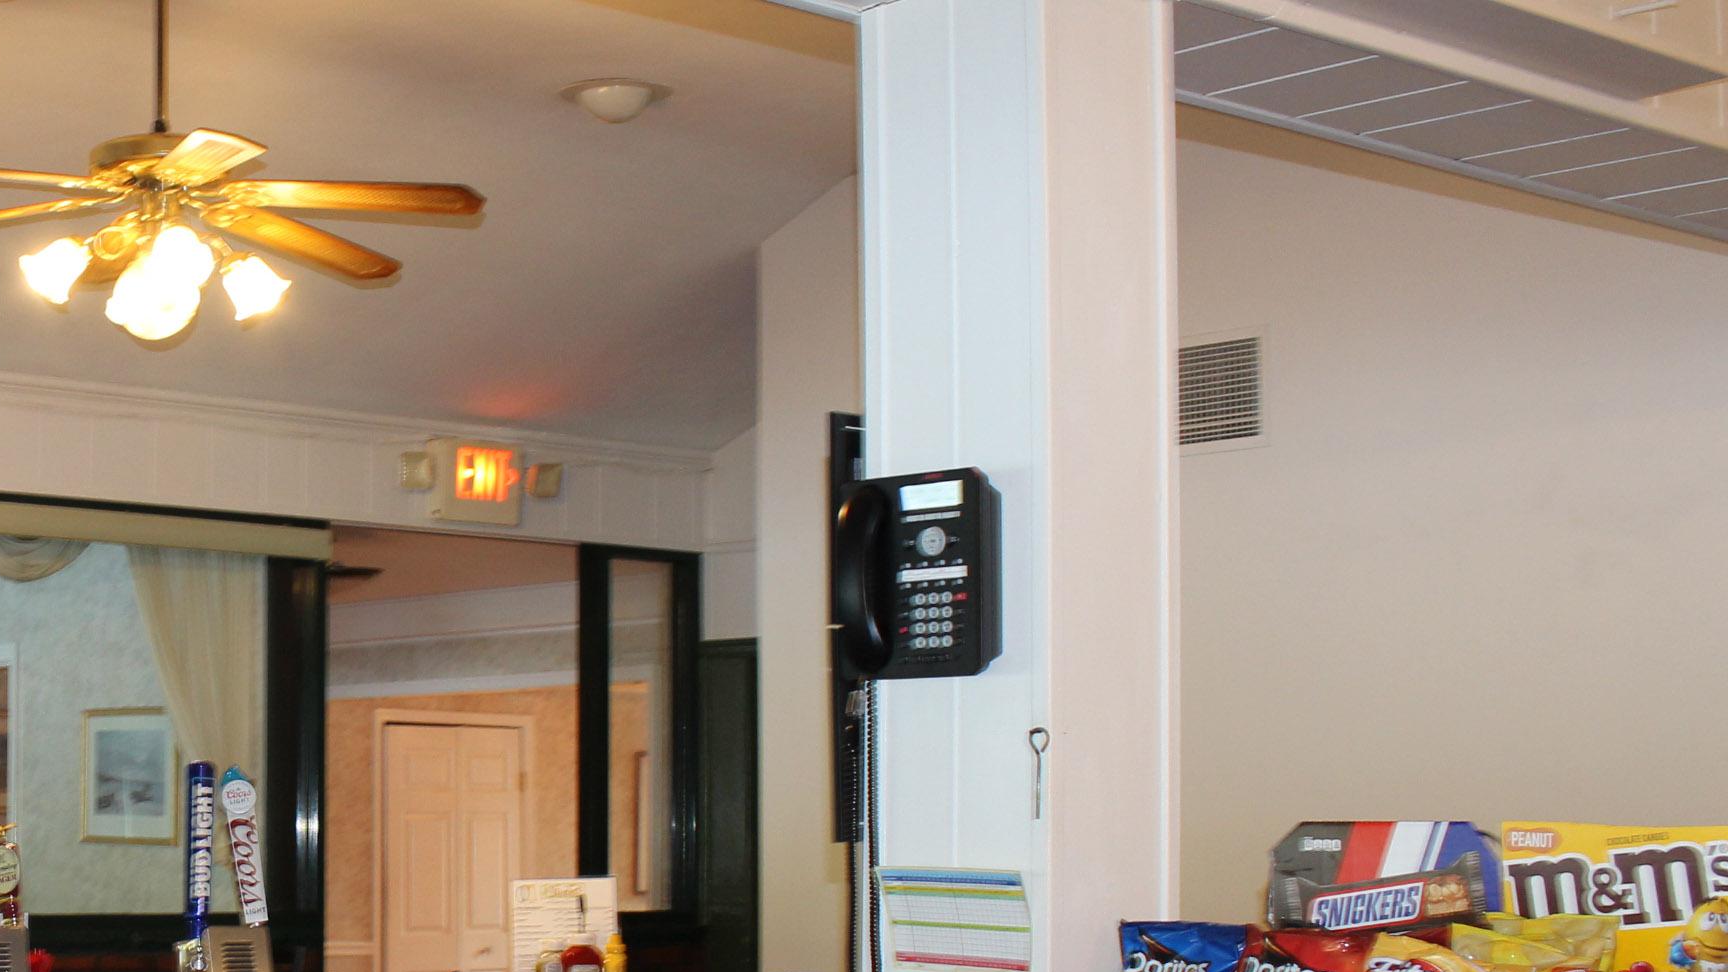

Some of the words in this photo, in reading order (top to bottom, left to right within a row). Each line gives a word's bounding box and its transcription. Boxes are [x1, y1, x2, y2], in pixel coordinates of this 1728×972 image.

[191, 783, 214, 848] LIGHT
[230, 814, 263, 907] Coors
[1510, 831, 1554, 848] PEANUT
[190, 849, 212, 899] BUD
[245, 906, 266, 916] LIGHT
[1315, 885, 1421, 930] SNICKERS
